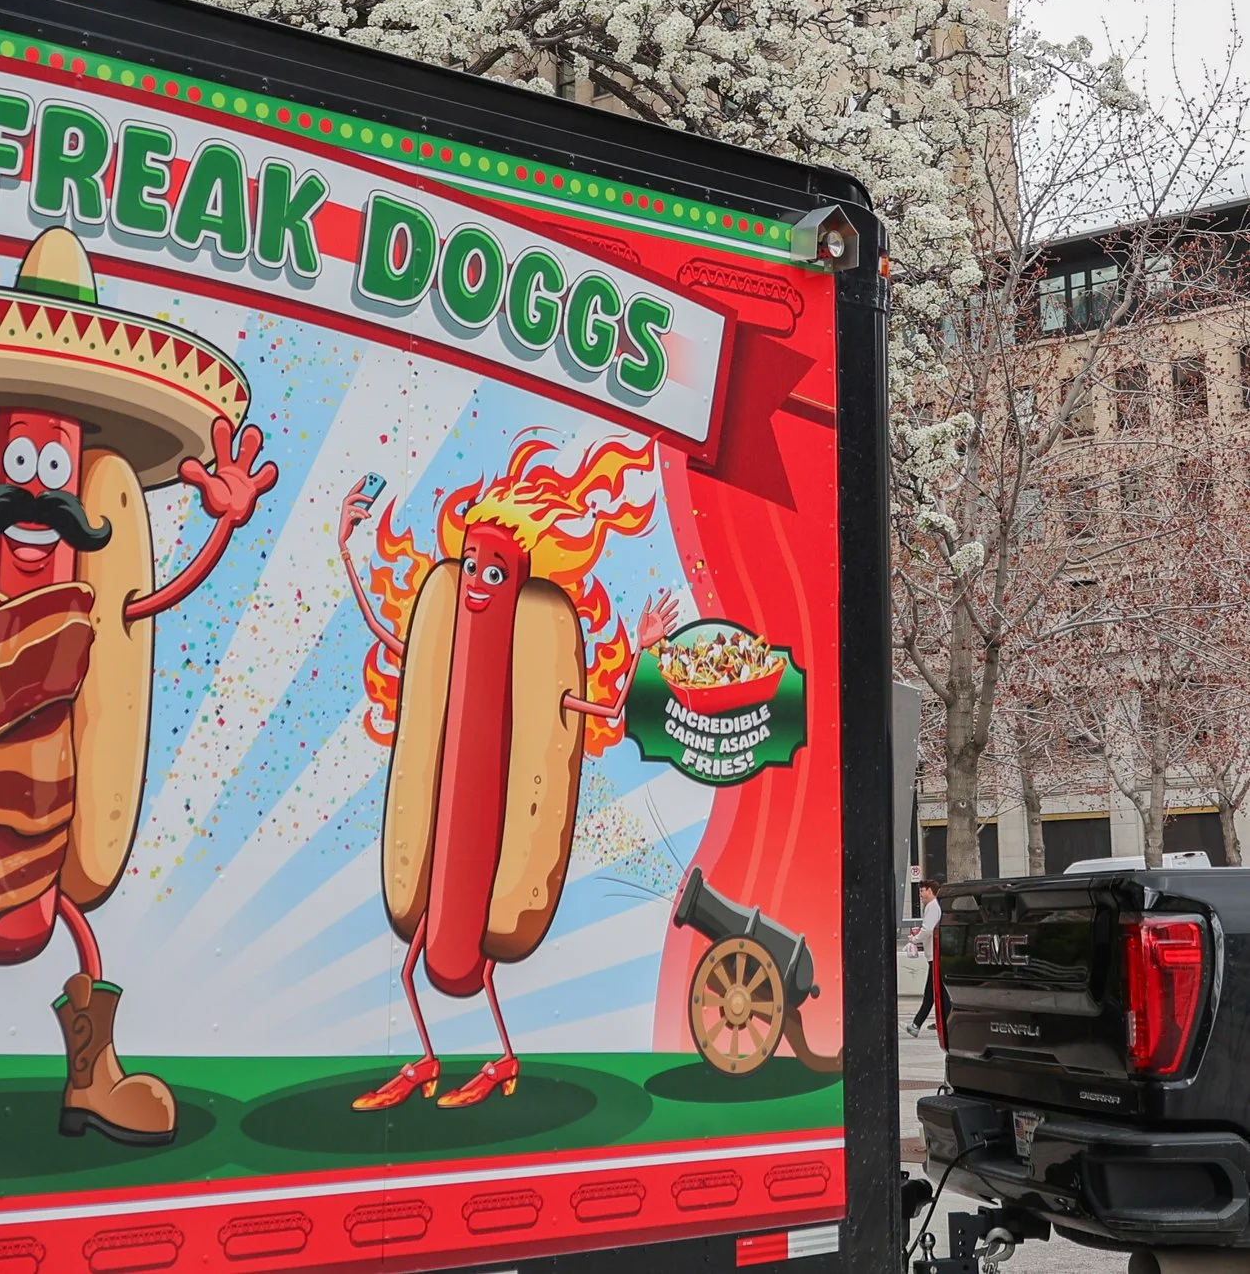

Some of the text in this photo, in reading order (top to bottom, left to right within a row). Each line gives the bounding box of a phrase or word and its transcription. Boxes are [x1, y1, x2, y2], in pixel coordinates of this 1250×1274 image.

[356, 190, 674, 399] DOGGS
[665, 697, 771, 735] INCREDIBLE
[665, 719, 771, 753] CARNE ASADA
[681, 748, 755, 776] FRIES!
[974, 933, 1029, 966] GMC
[990, 1021, 1041, 1038] DENALI
[1079, 1091, 1121, 1105] SIERRA
